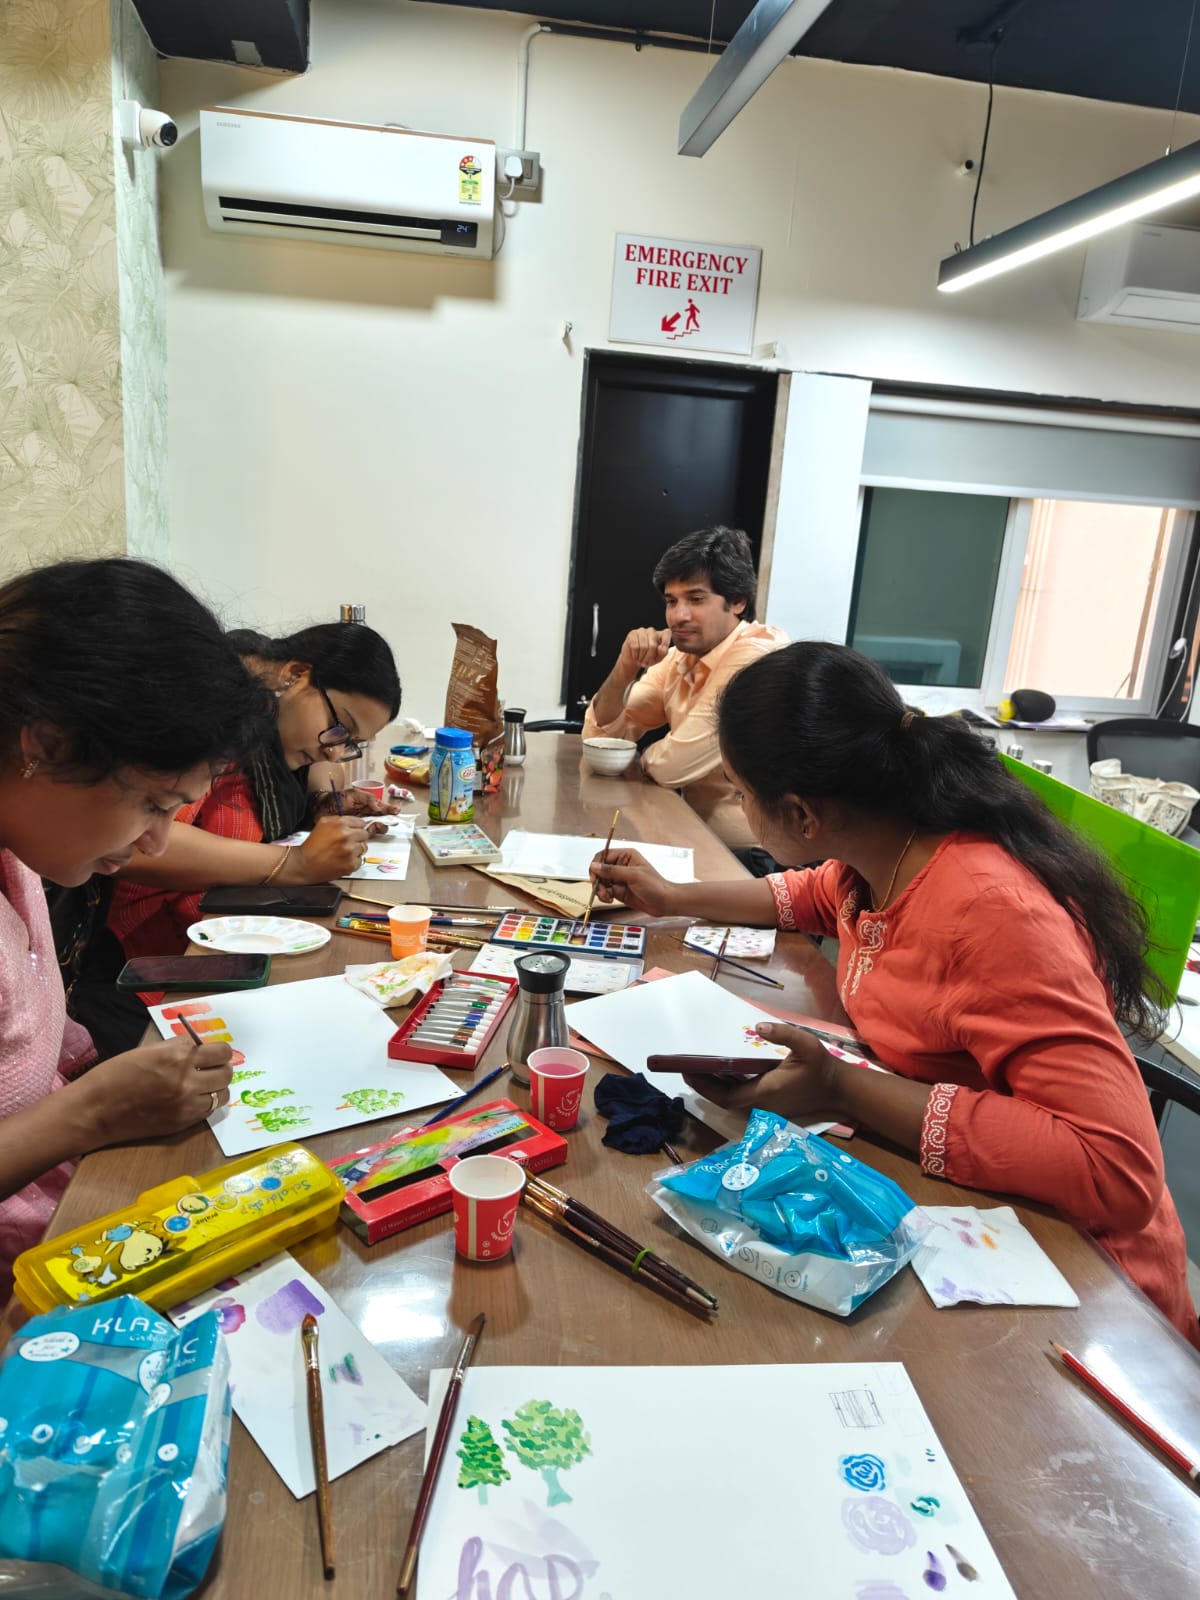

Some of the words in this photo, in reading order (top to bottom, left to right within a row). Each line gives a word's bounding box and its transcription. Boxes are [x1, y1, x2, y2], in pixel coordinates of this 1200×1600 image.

[624, 243, 749, 275] EMERGENCY
[636, 267, 682, 289] FIRE
[686, 273, 733, 295] EXIT
